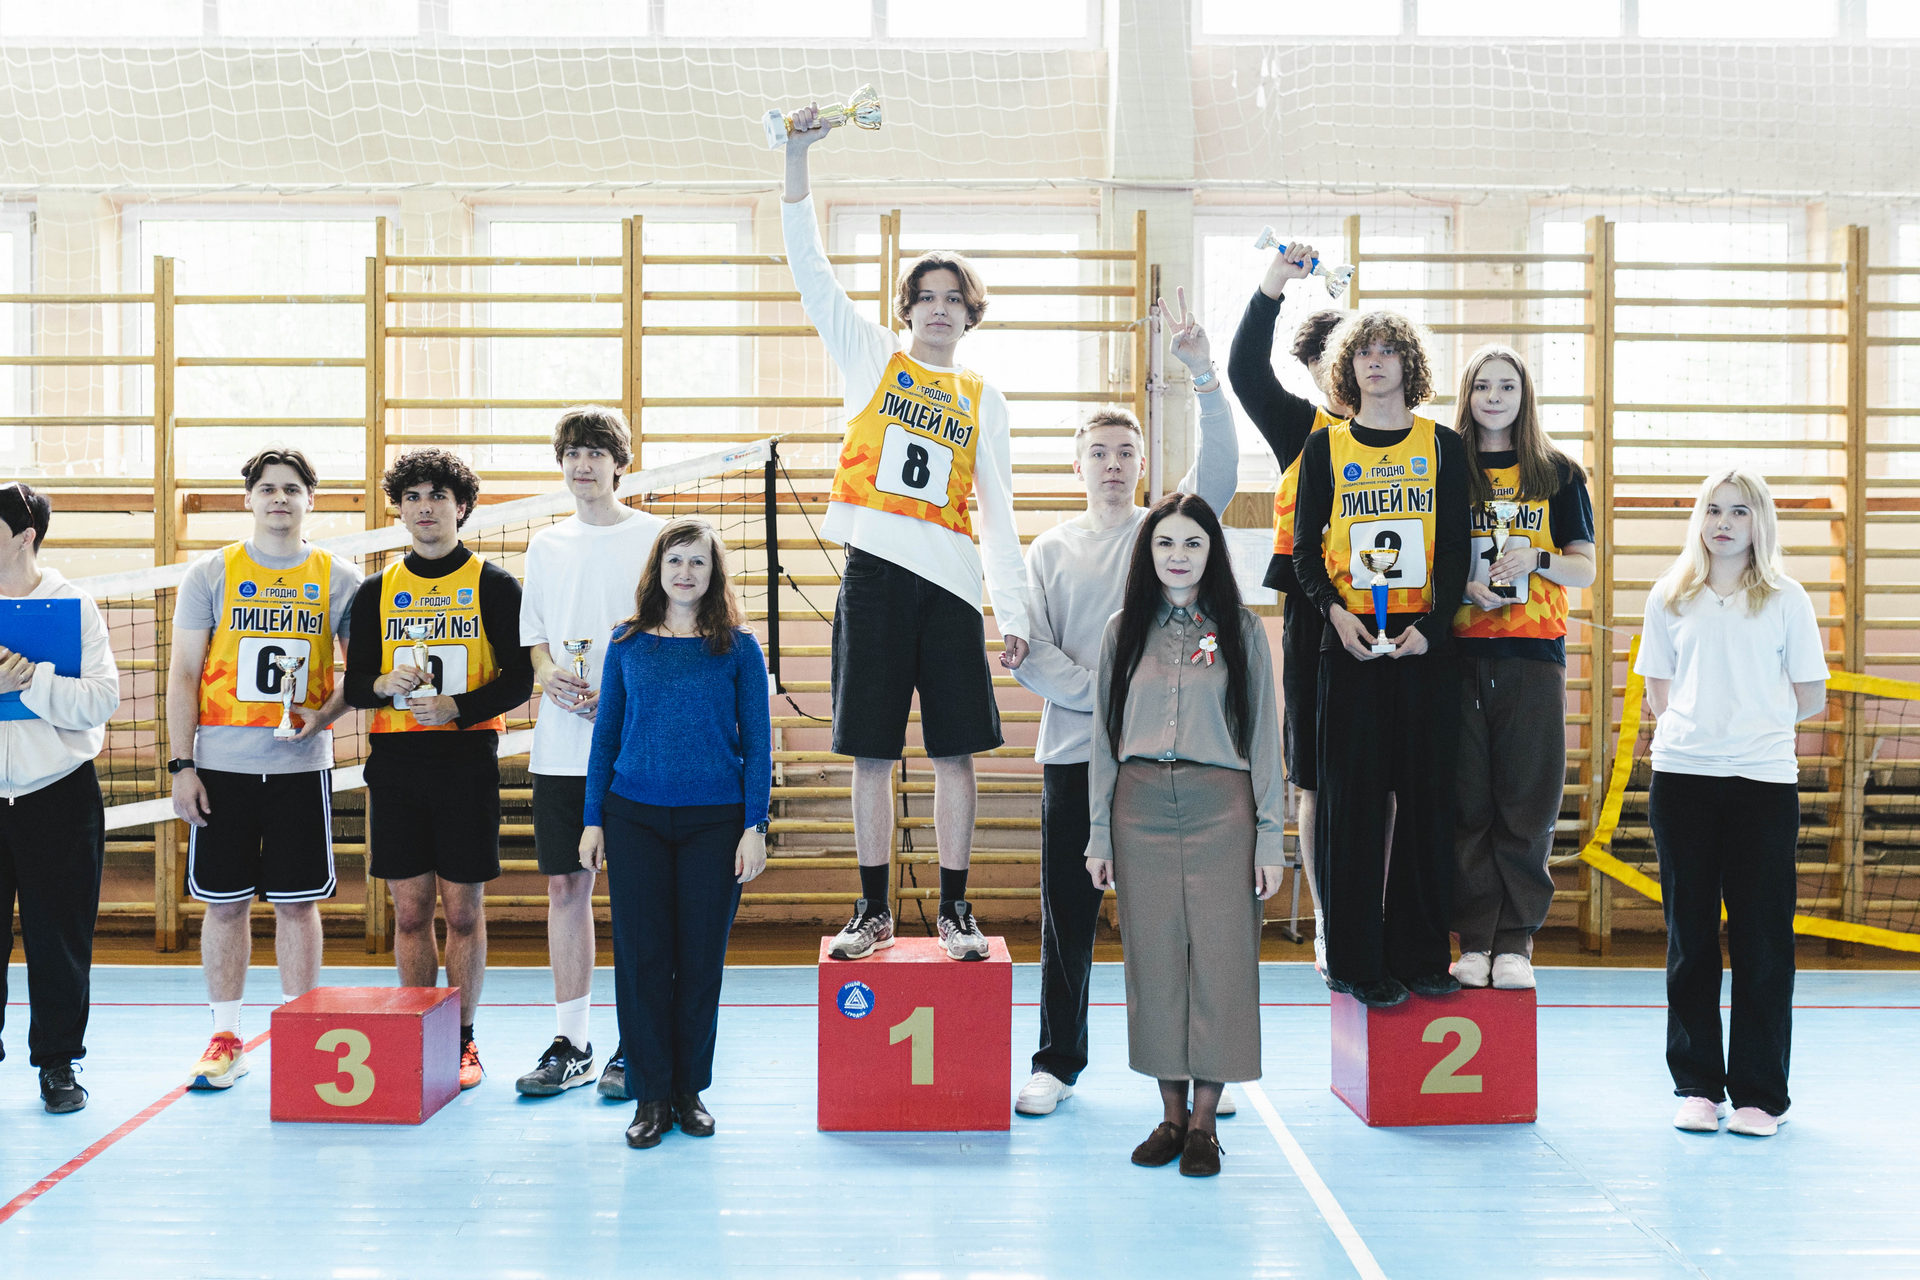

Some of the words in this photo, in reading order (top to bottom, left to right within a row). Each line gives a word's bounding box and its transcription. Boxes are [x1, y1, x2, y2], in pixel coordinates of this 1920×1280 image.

[921, 385, 952, 404] ГРОДНО
[878, 391, 943, 436] ЛИЦЕЙ
[942, 416, 974, 448] №1
[901, 442, 931, 489] 8
[1370, 464, 1406, 478] ГРОДНО
[1340, 483, 1404, 518] ЛИЦЕЙ
[1407, 487, 1434, 513] №1
[1515, 504, 1544, 531] №1
[265, 587, 298, 599] ГРОДНО
[420, 596, 451, 608] ГРОДНО
[229, 604, 293, 634] ЛИЦЕЙ
[297, 610, 324, 635] №1
[450, 615, 479, 639] №1
[256, 644, 287, 695] 6
[889, 1006, 934, 1085] 1
[1420, 1016, 1483, 1094] 2
[314, 1028, 375, 1107] 3
